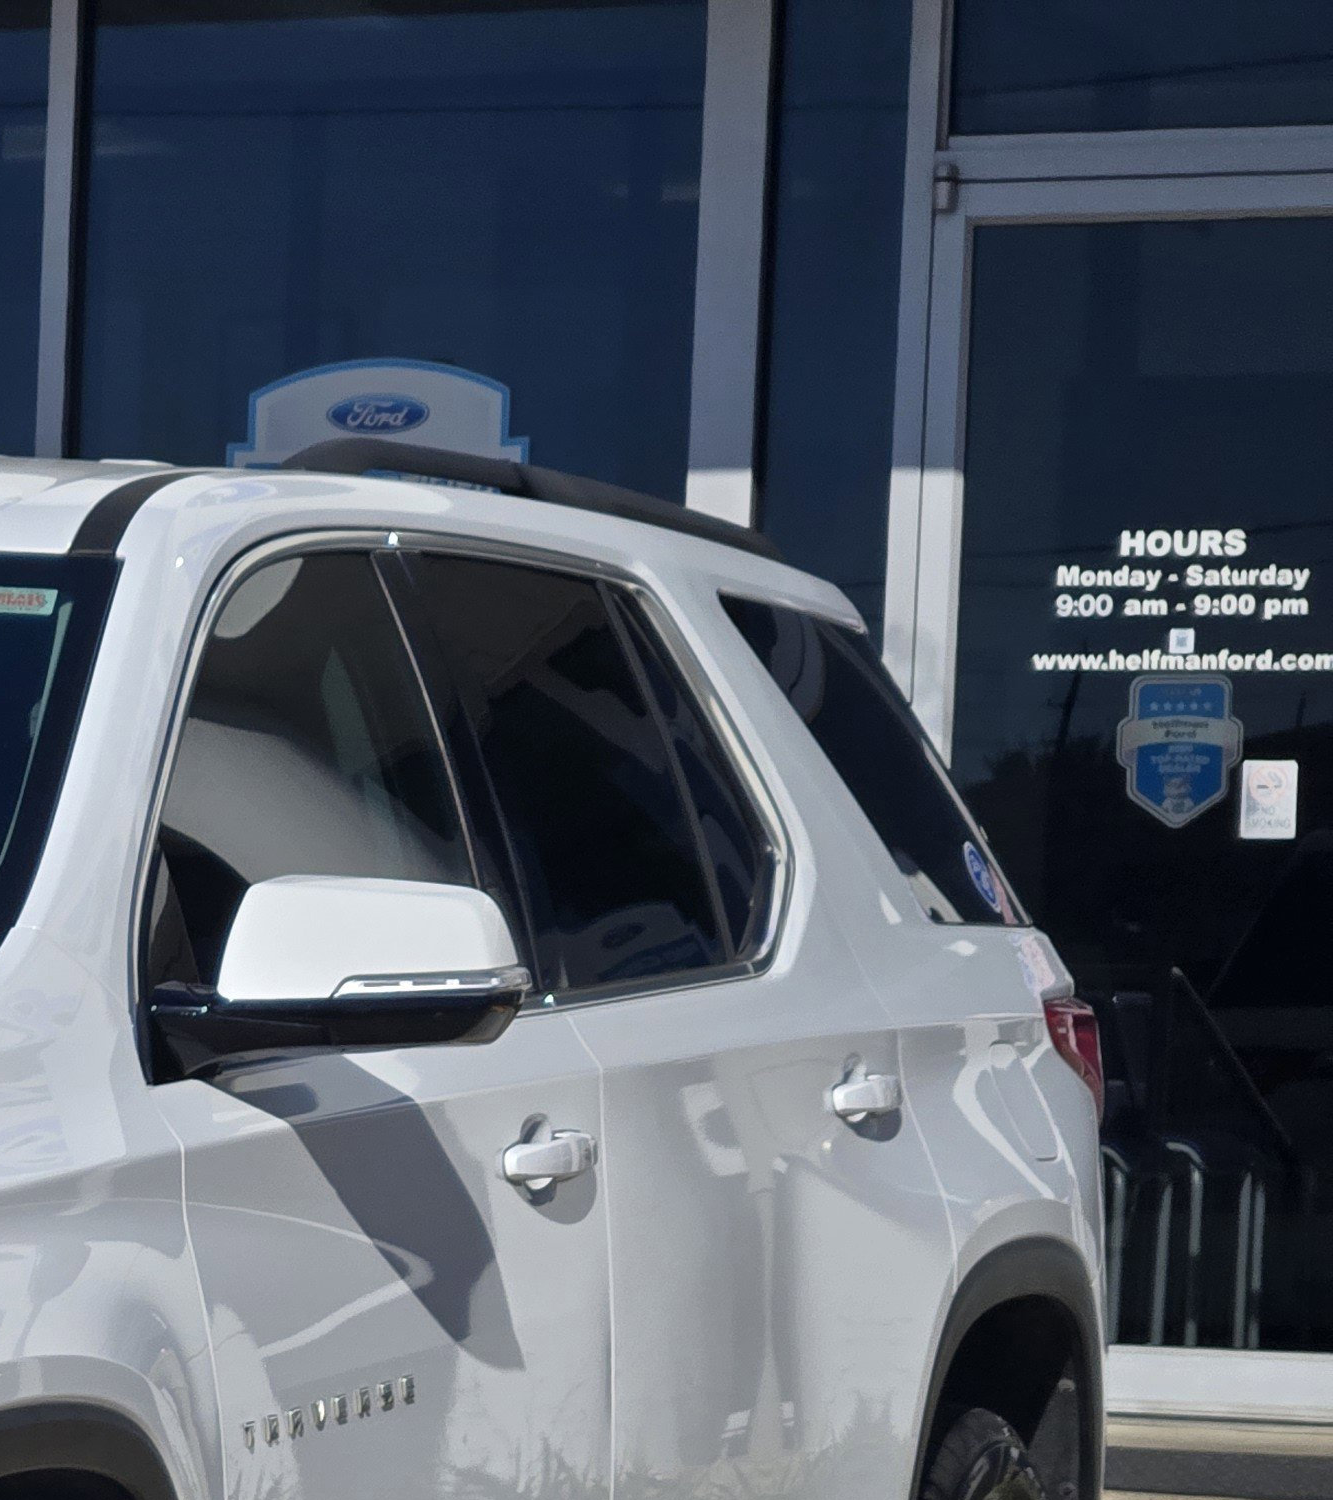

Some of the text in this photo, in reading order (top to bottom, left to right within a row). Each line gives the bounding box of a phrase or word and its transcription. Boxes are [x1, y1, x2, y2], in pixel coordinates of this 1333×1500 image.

[346, 400, 409, 428] Ford
[1119, 528, 1247, 557] HOURS
[1055, 564, 1310, 591] Monday - Saturday
[1056, 594, 1309, 620] 9:00 am - 9:00 pm
[1032, 649, 1333, 671] www.helfmanford.com
[243, 1374, 416, 1453] TRAVERSE
